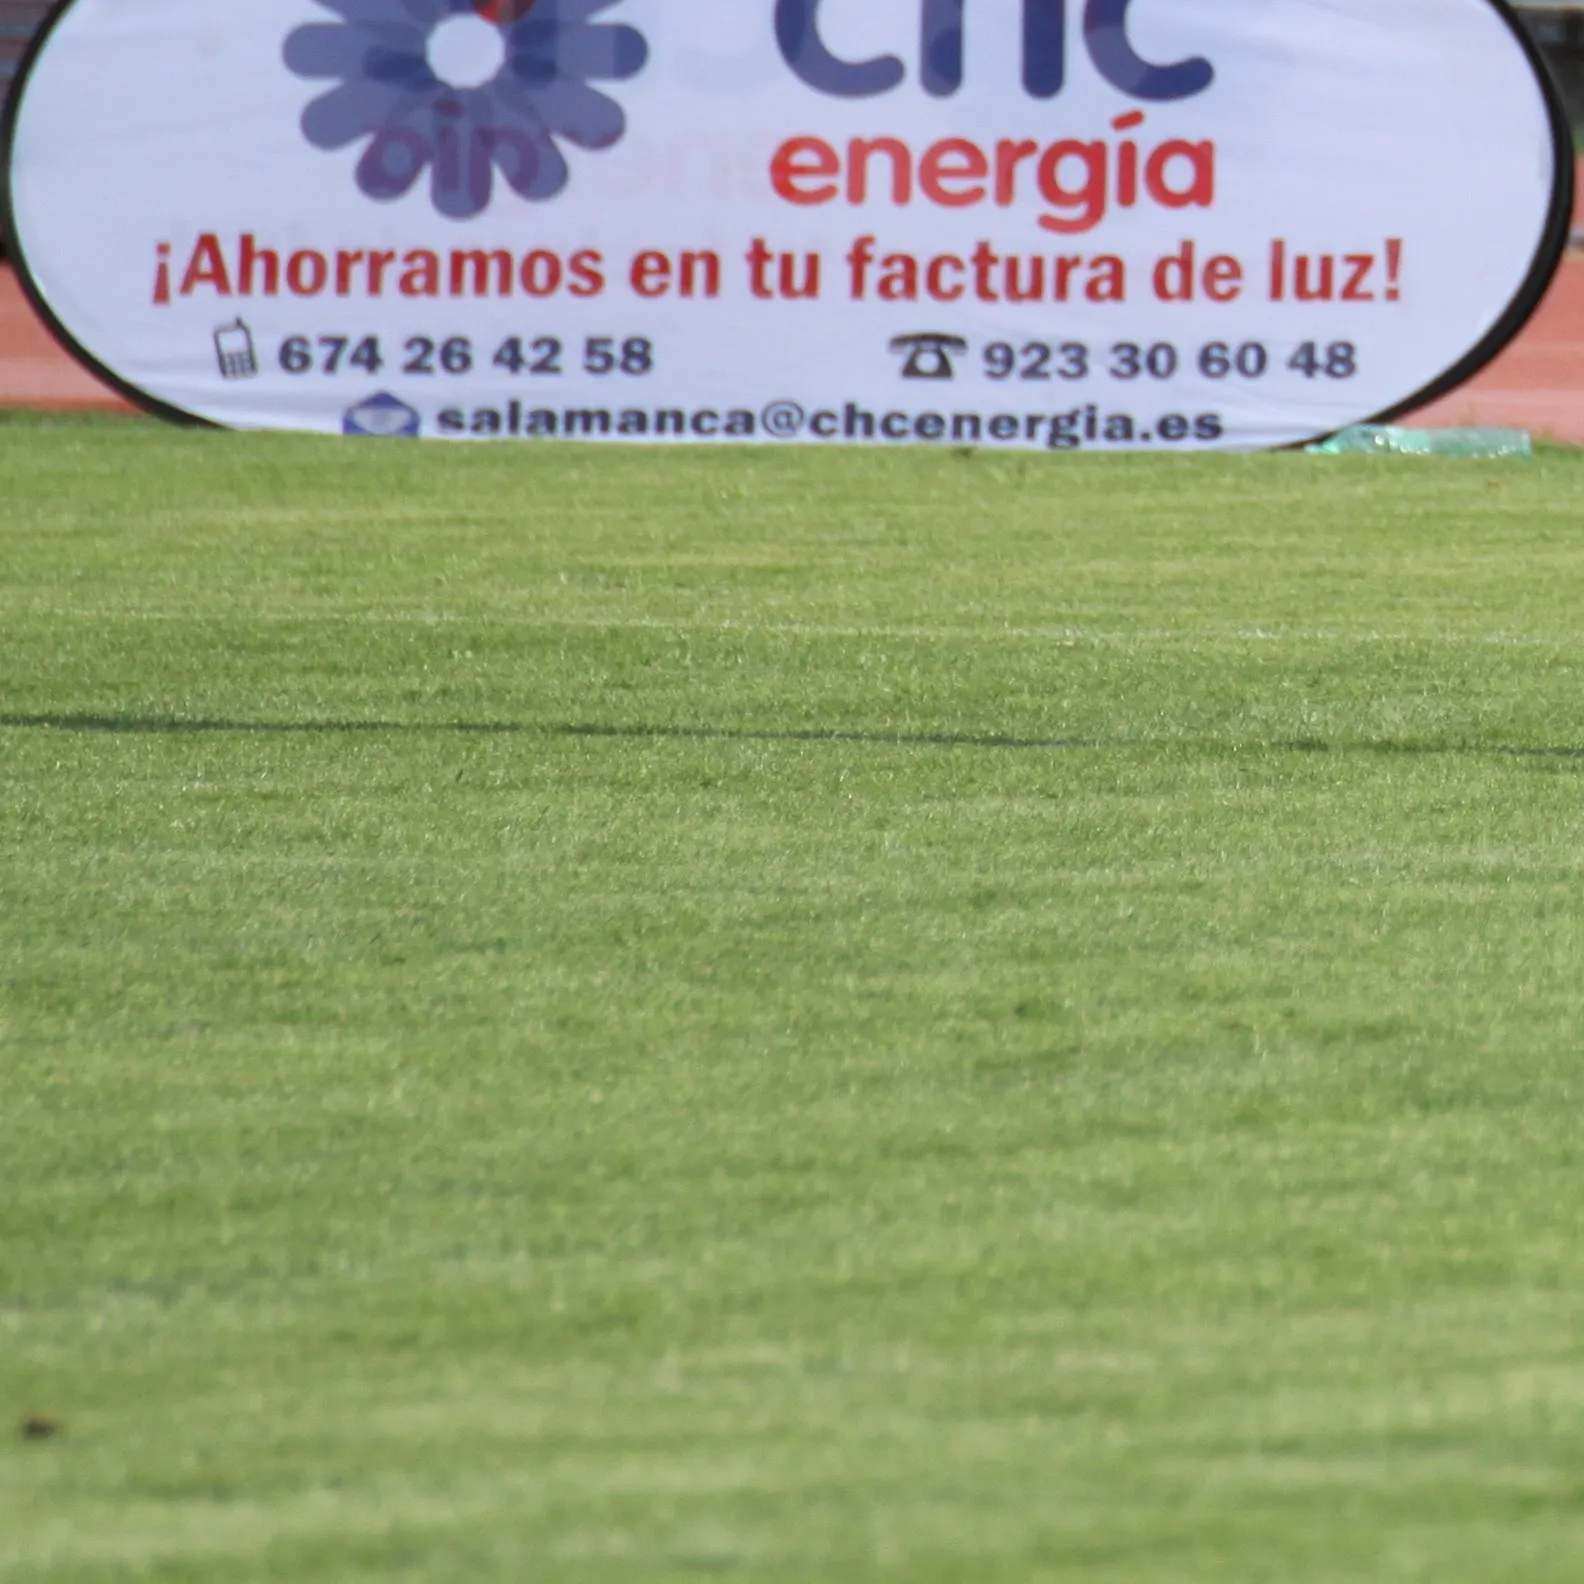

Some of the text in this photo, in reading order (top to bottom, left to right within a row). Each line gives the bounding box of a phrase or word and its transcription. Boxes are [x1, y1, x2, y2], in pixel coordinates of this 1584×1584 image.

[769, 110, 1215, 234] energía
[153, 233, 1402, 304] ¡Ahorramos en tu factura de luz!
[278, 335, 655, 376] 674 26 42 58
[982, 341, 1357, 380] 923 30 60 48
[435, 399, 1223, 449] salamanca@chcenergia.es
